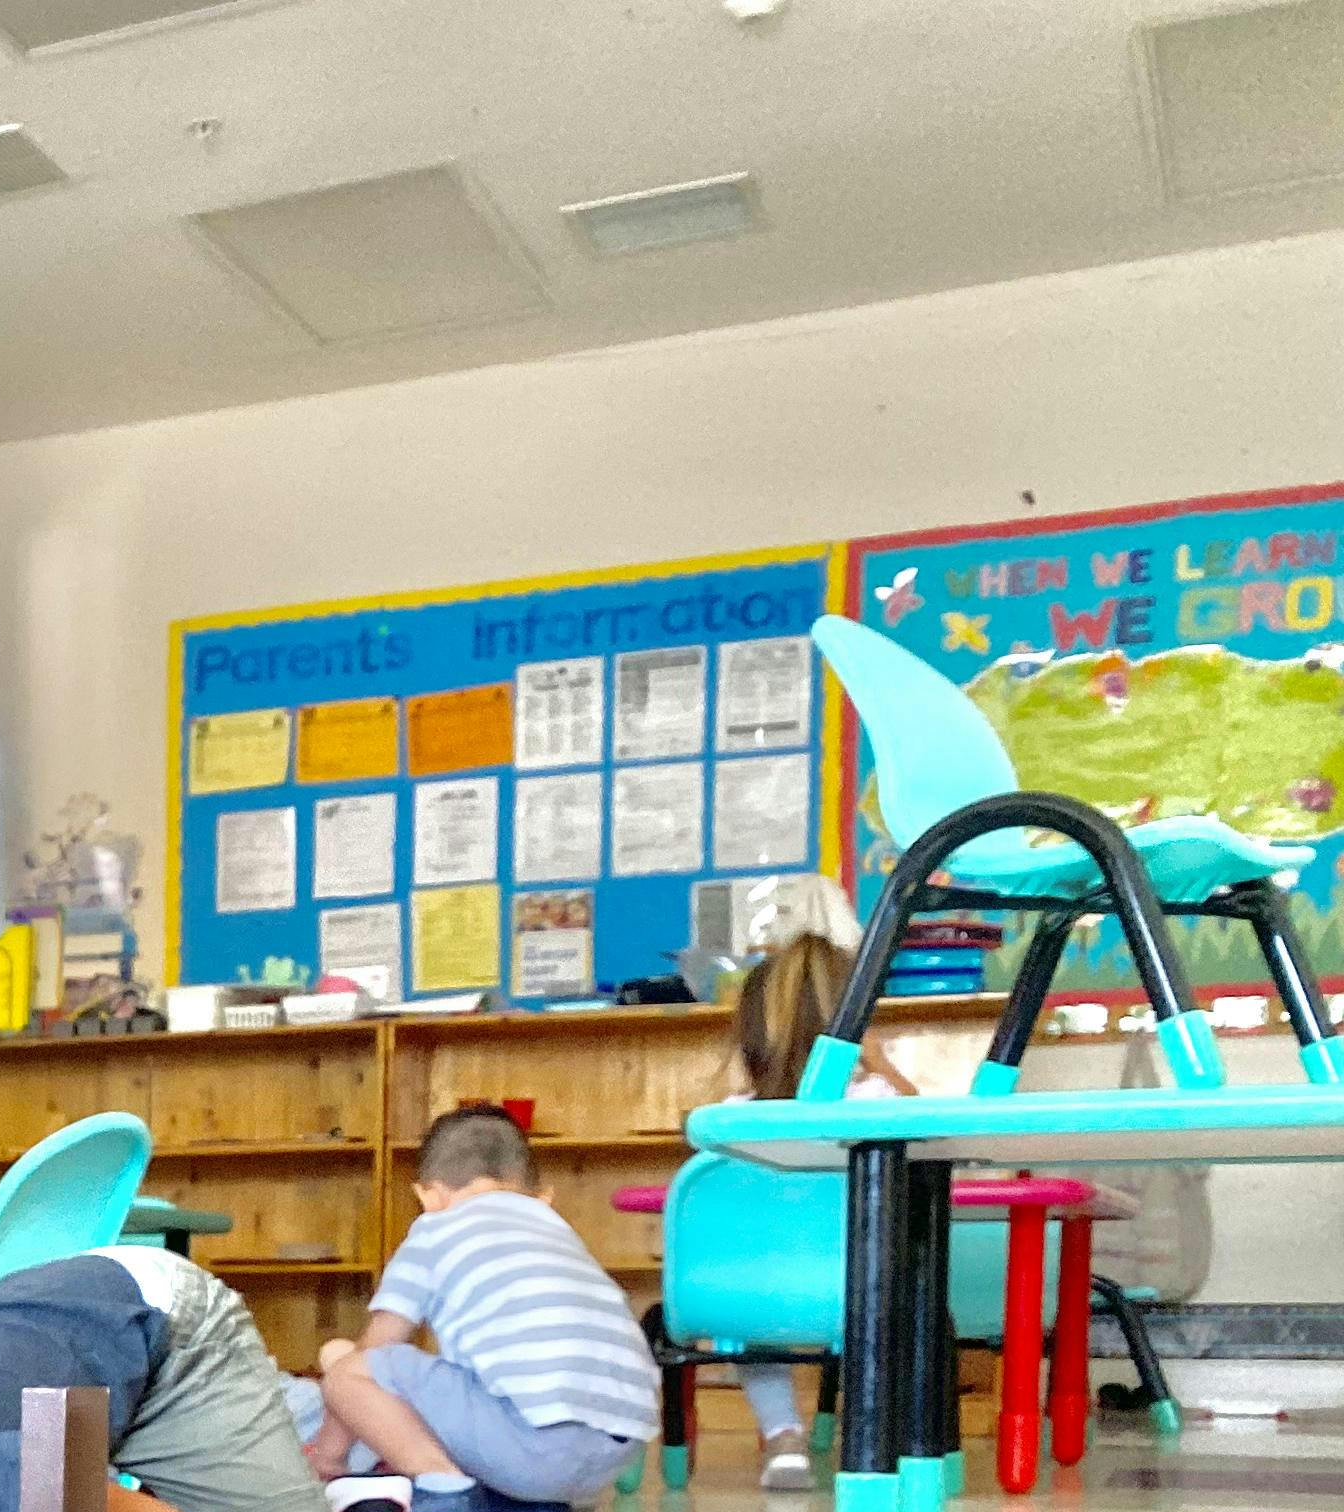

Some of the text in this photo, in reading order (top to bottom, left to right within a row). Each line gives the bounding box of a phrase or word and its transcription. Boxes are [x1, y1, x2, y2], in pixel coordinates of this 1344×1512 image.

[944, 530, 1337, 598] WHEN WE LEARN
[472, 582, 814, 660] Information
[1048, 575, 1344, 650] WE GRO
